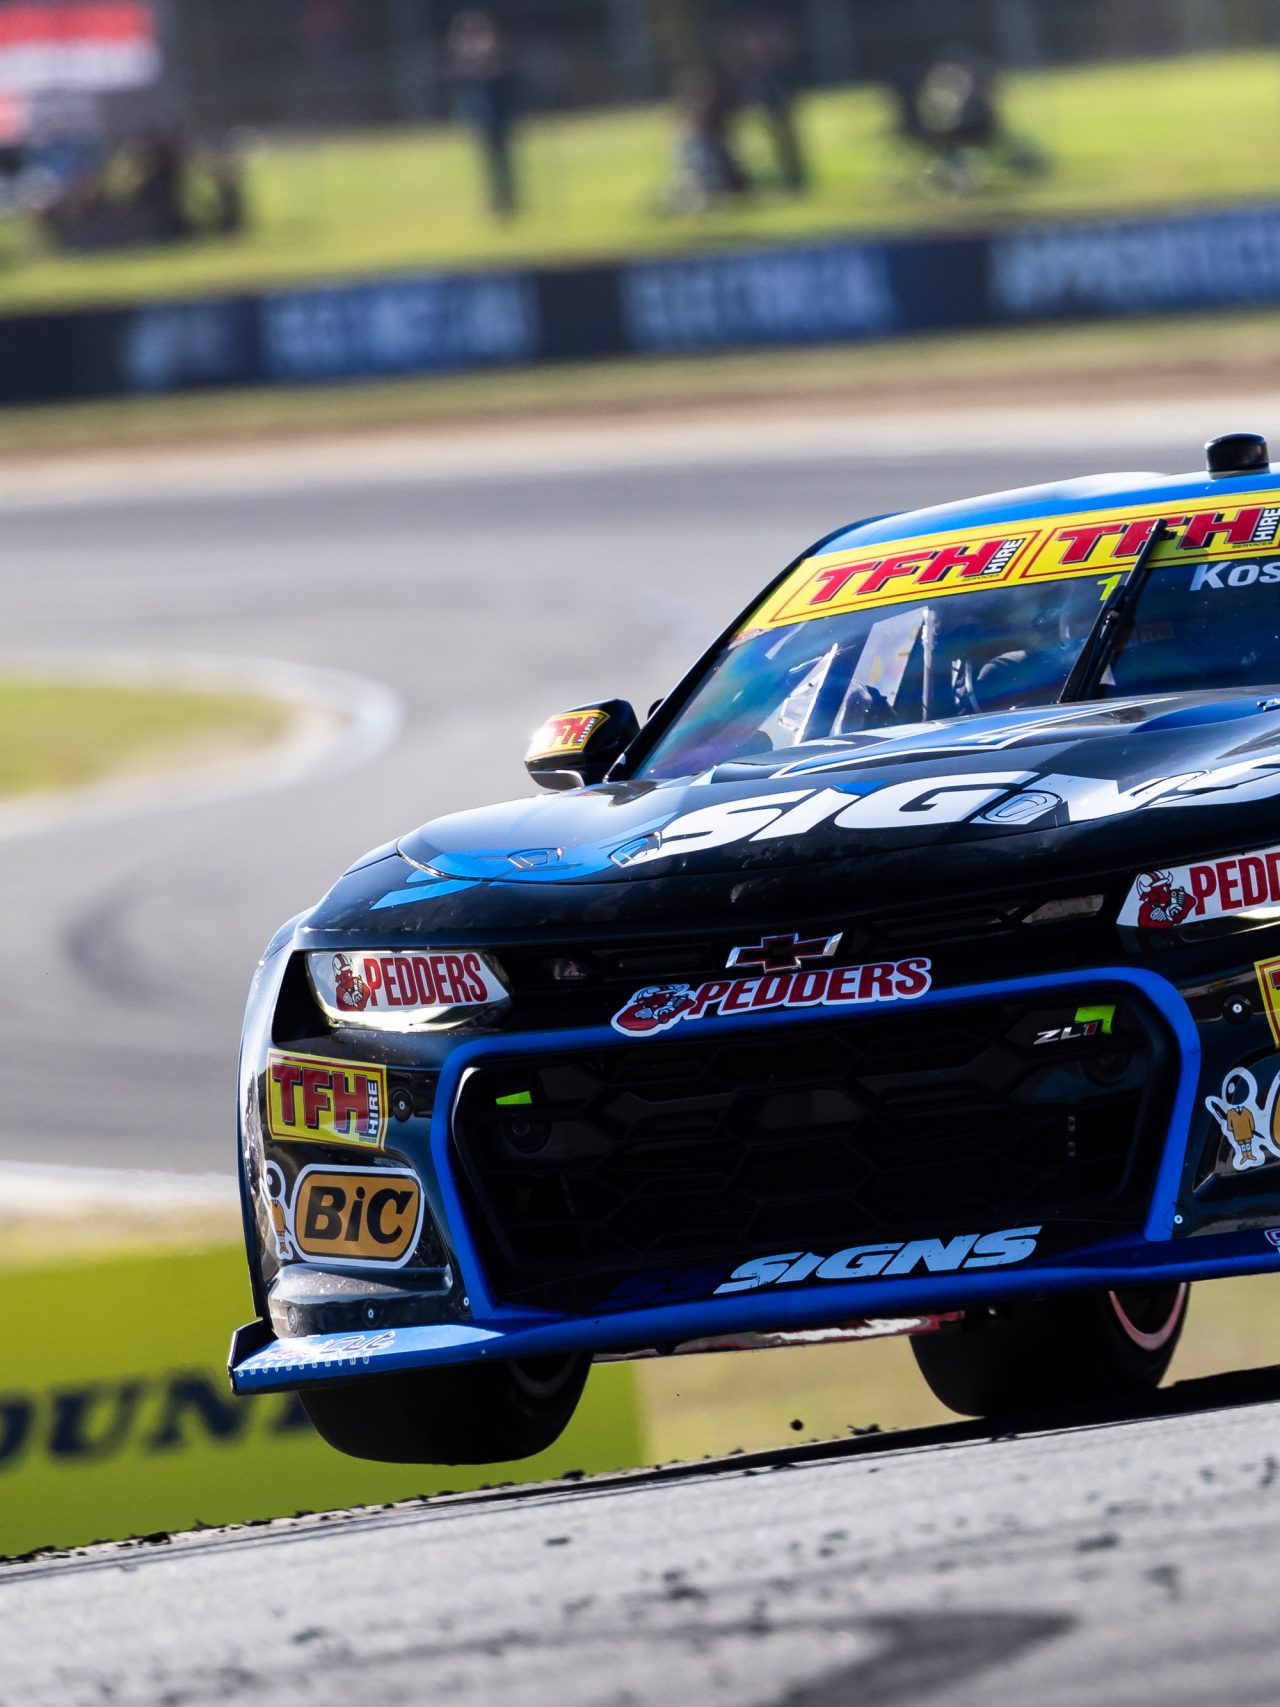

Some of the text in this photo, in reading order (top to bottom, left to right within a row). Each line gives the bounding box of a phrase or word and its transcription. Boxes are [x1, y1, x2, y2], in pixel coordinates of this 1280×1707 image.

[984, 538, 1024, 574] HIRE
[1057, 507, 1263, 565] TFH
[808, 539, 1008, 605] TFH
[364, 953, 488, 1007] PEDDERS
[695, 958, 931, 1018] PEDDERS
[272, 1063, 369, 1134] TFH
[368, 1081, 379, 1135] HIRE
[303, 1185, 414, 1245] BiC
[713, 1226, 1043, 1295] SIGNS
